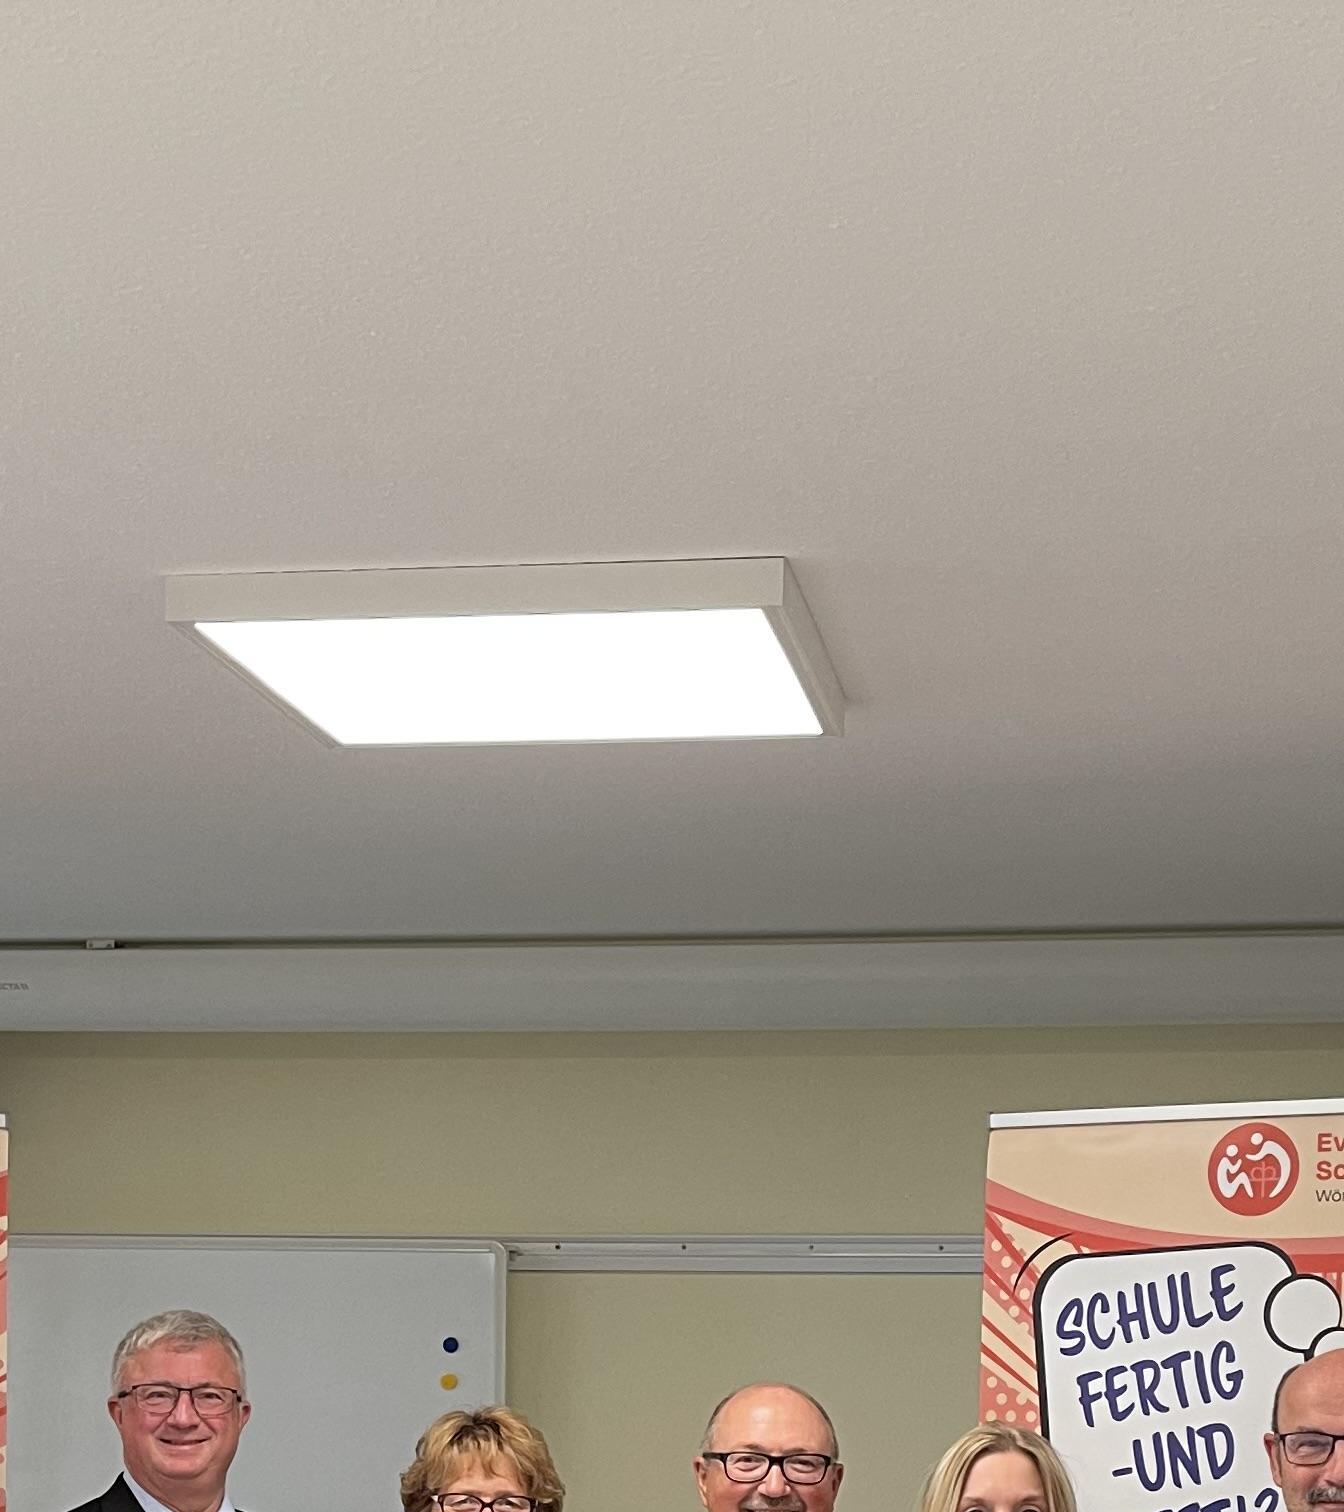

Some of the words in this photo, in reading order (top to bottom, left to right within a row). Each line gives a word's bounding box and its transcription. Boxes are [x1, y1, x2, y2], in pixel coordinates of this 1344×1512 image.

[1055, 1263, 1244, 1357] SCHULE
[1076, 1340, 1244, 1428] FERTIG
[1111, 1422, 1235, 1492] -UND
